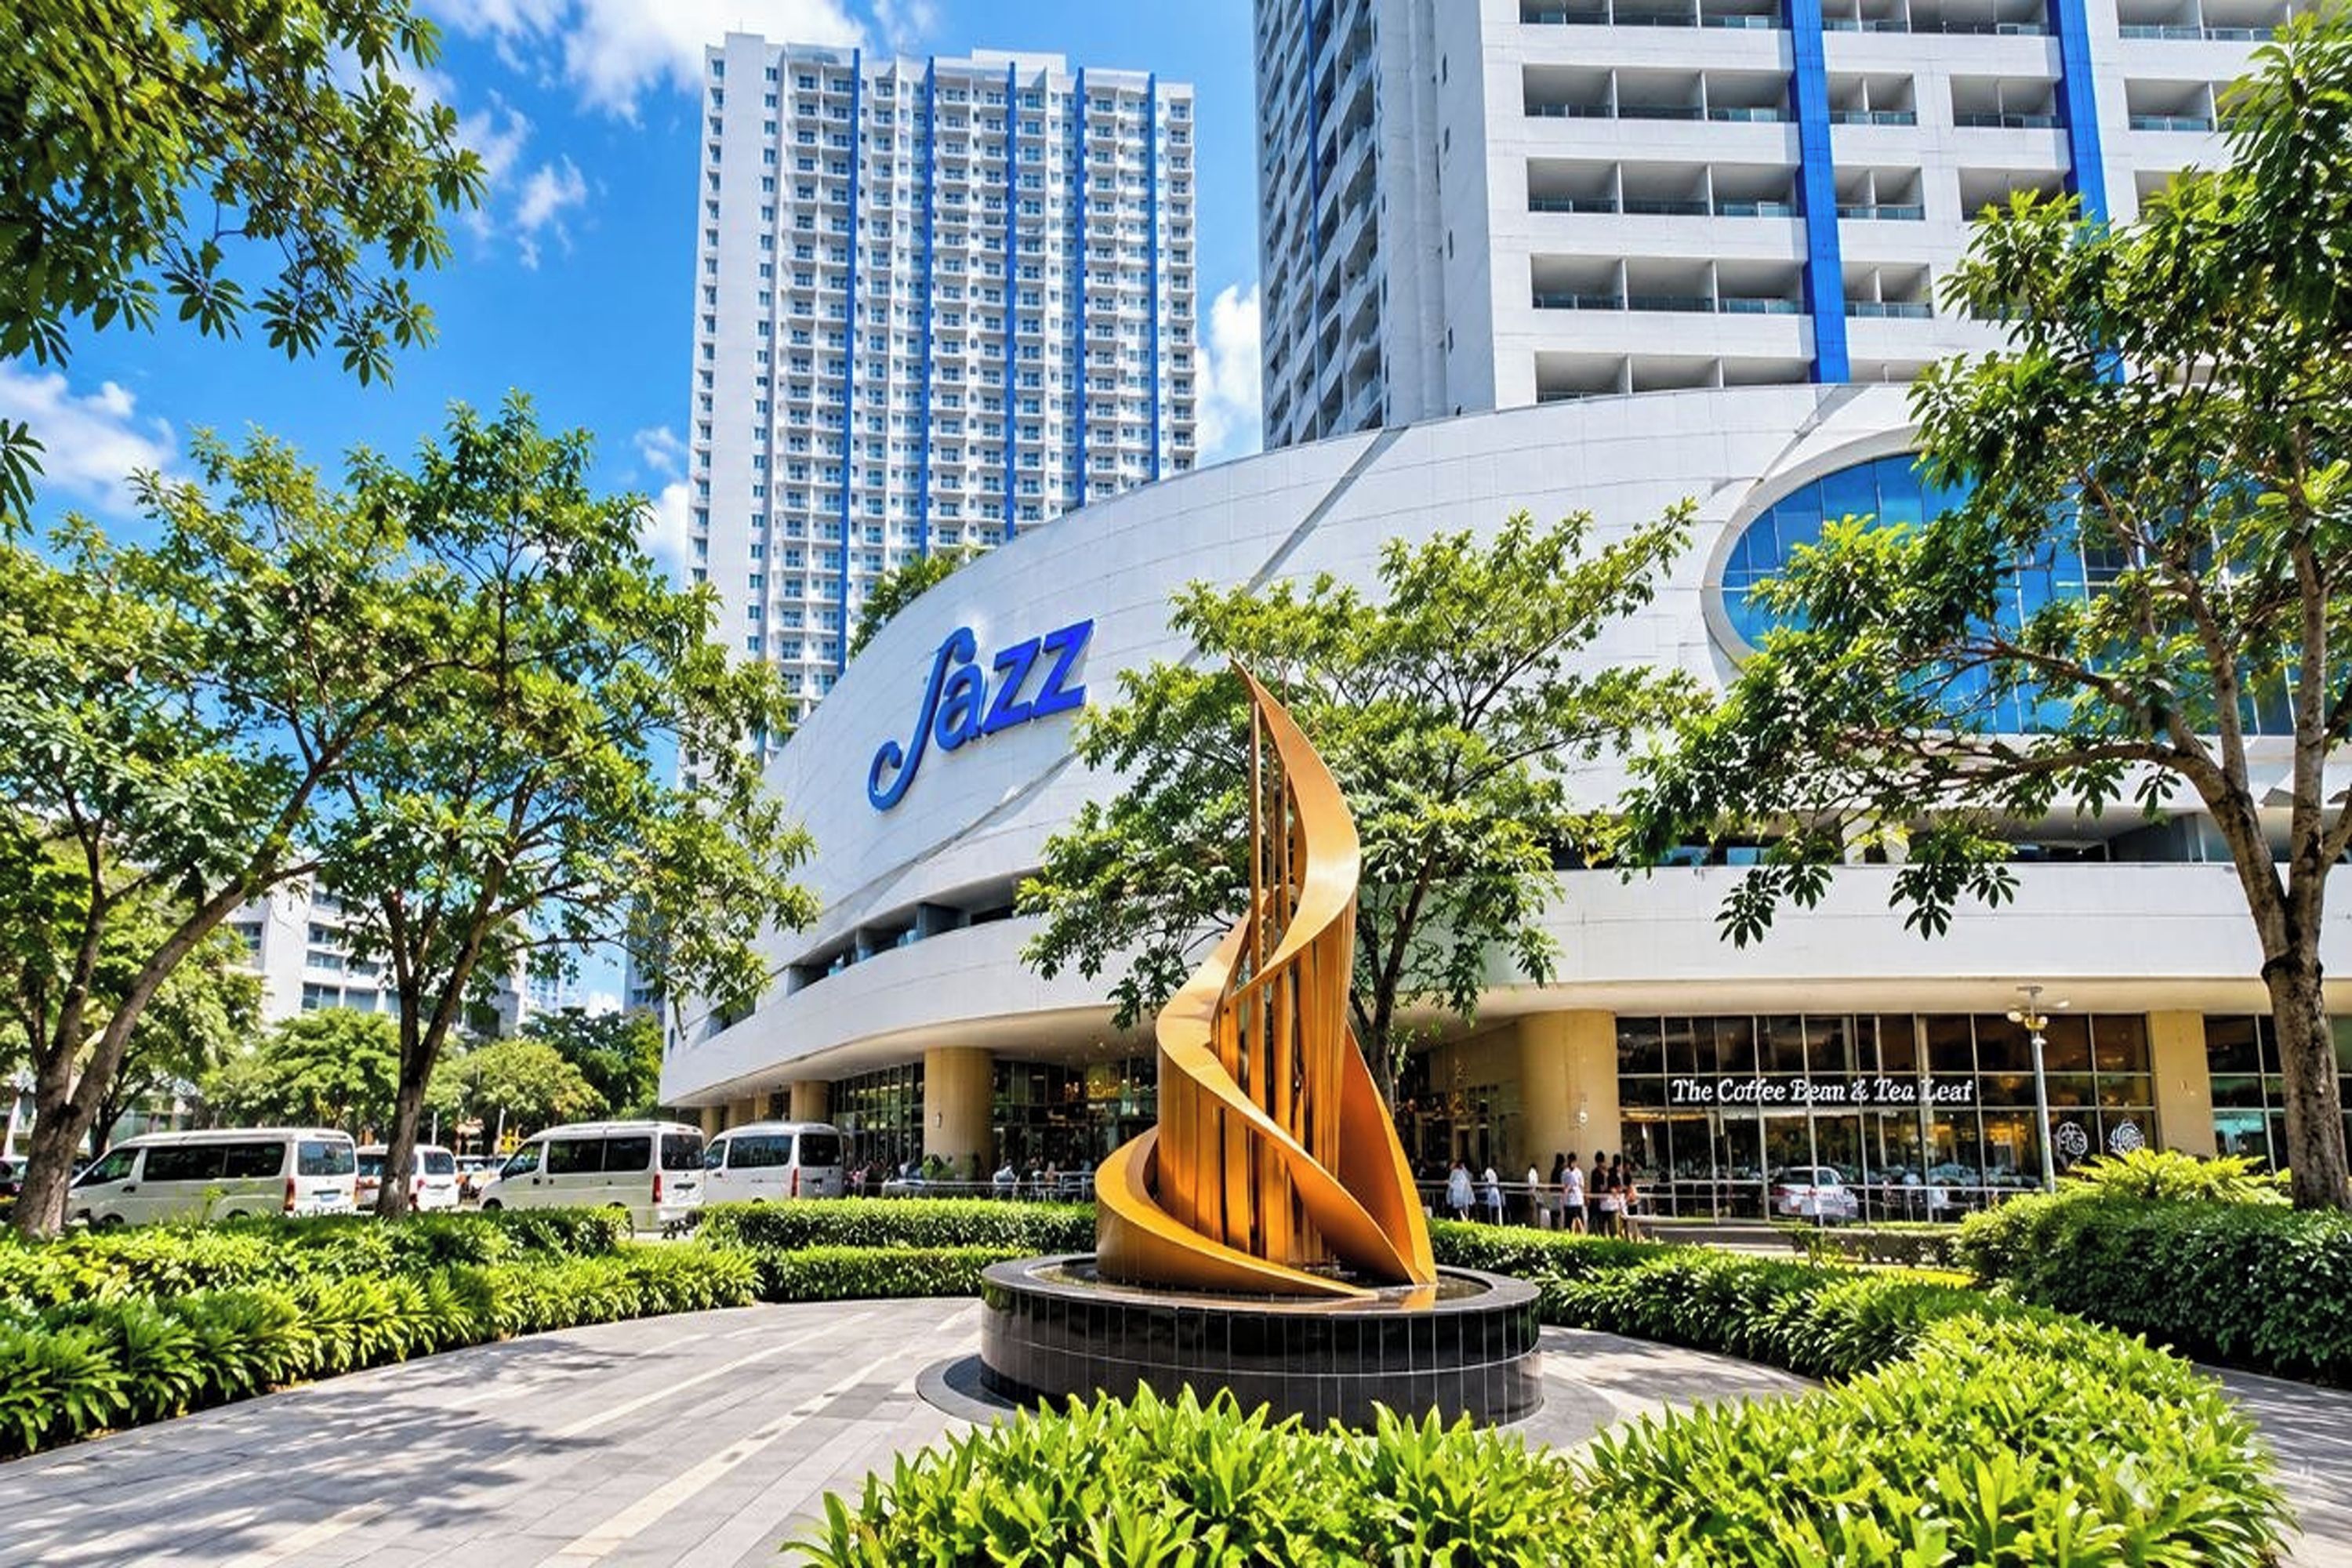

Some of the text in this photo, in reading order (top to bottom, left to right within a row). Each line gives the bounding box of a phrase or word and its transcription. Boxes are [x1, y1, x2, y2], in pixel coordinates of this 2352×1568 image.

[1671, 1078, 1973, 1102] The Coffee Bean & Tea Leaf
